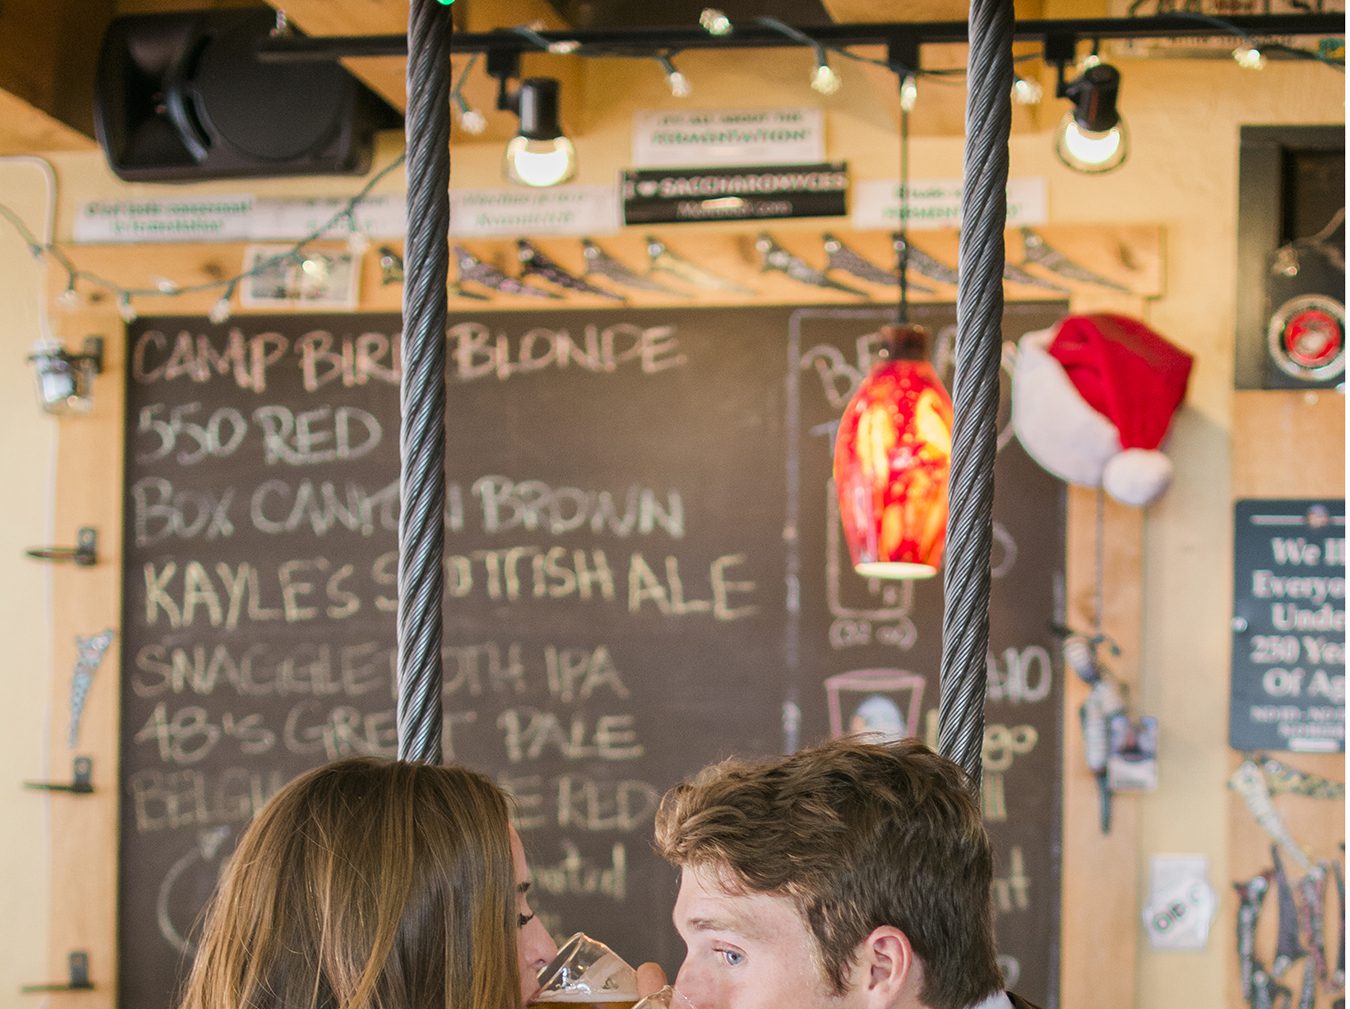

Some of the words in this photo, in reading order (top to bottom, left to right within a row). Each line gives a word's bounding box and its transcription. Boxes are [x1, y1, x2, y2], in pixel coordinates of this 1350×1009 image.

[132, 327, 289, 393] CAMP
[295, 330, 402, 392] BIR
[445, 321, 688, 382] BLONDE
[133, 402, 248, 466] 550
[252, 403, 383, 466] RED
[132, 476, 237, 548] BOX
[470, 474, 686, 539] BROWN
[1271, 536, 1322, 566] We
[143, 557, 361, 632] KAYLE'S
[371, 545, 616, 613] SOTTISH
[627, 552, 758, 622] ALE
[544, 643, 632, 702] IPA
[1250, 634, 1300, 664] 250
[1262, 667, 1305, 697] Of
[282, 700, 478, 761] GRET
[496, 704, 646, 763] PALE
